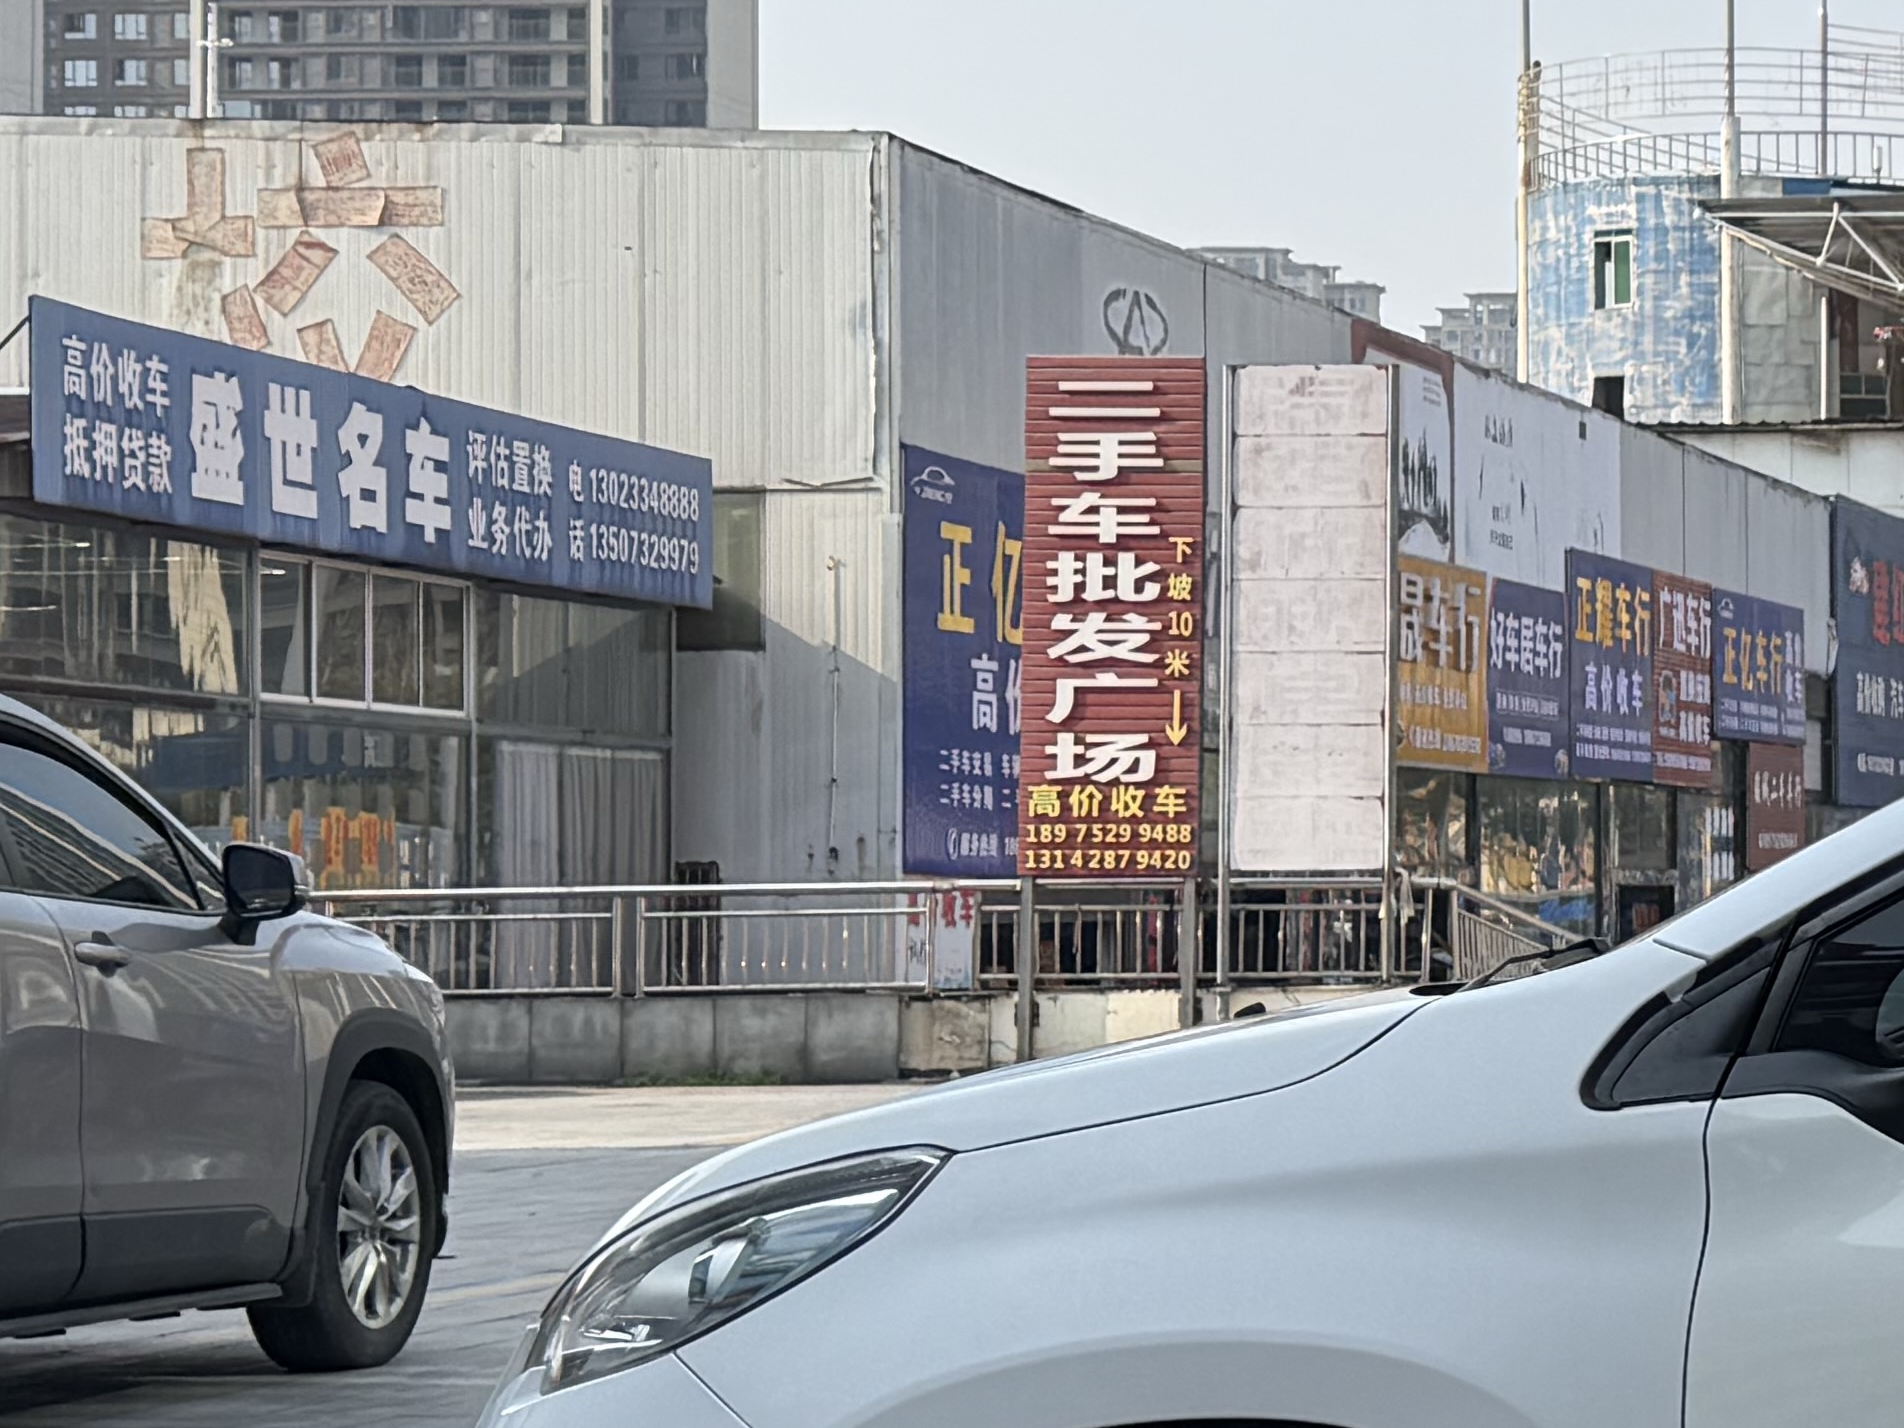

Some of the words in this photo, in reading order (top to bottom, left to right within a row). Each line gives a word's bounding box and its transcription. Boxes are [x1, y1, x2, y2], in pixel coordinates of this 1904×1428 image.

[62, 334, 171, 418] 高价收车
[63, 412, 173, 495] 抵押贷款
[189, 370, 452, 544] 盛世名车
[466, 429, 552, 497] 评估置换
[589, 467, 699, 522] 13023348888
[467, 497, 552, 562] 业务代办
[589, 522, 699, 576] 13507329979
[1044, 380, 1165, 783] 二手车批发广场
[1027, 784, 1187, 819] 高价收车
